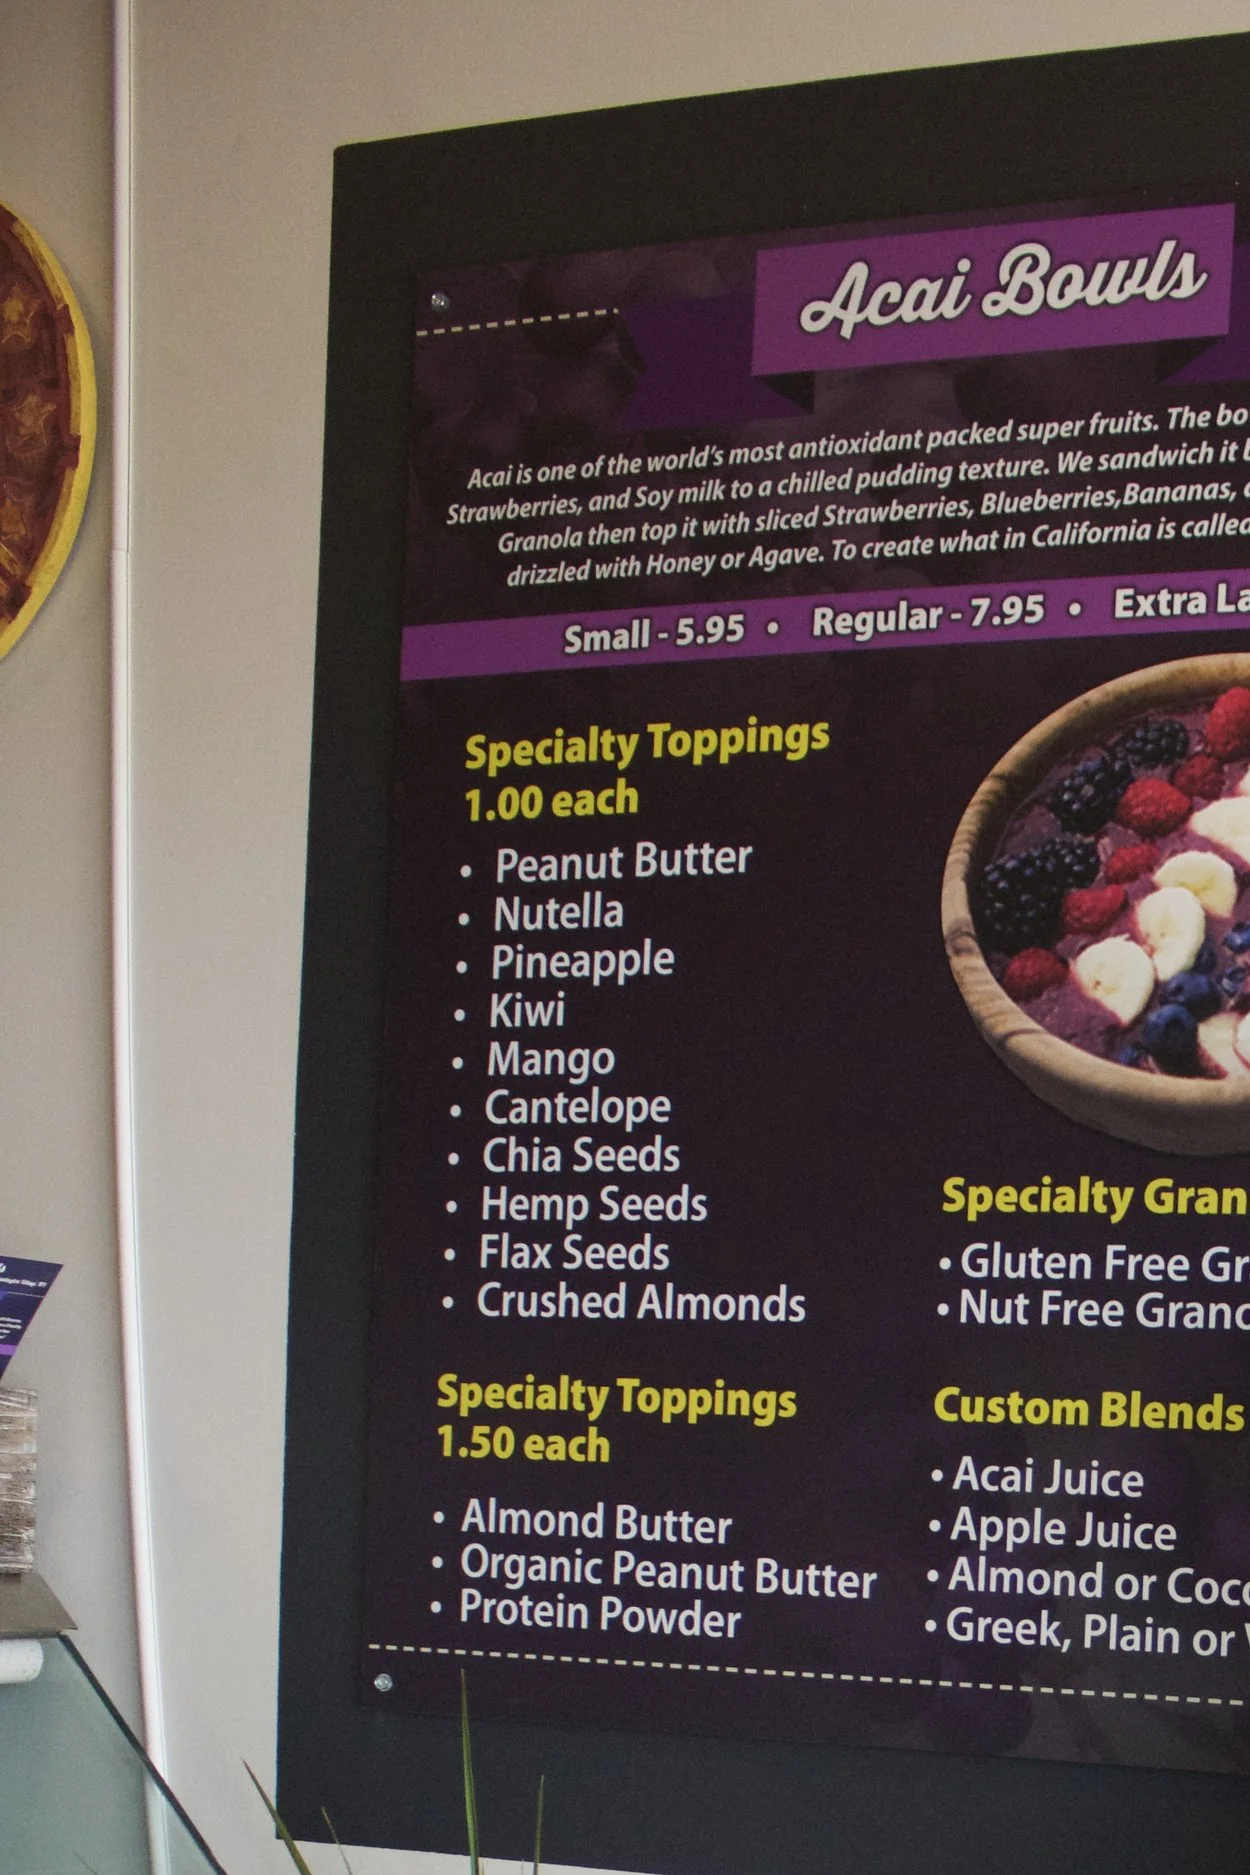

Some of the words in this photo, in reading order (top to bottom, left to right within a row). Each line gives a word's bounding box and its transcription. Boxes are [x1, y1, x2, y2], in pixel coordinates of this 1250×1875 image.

[801, 259, 971, 339] Acai
[982, 241, 1207, 316] Bowls
[467, 465, 513, 489] Acai
[516, 464, 532, 484] is
[537, 464, 576, 482] one
[581, 455, 605, 478] of
[608, 454, 642, 475] the
[729, 442, 784, 464] most
[789, 430, 923, 459] antioxidant
[926, 419, 1013, 453] packed
[1017, 420, 1084, 444] super
[1089, 411, 1158, 435] fruits.
[1168, 406, 1211, 429] The
[447, 495, 582, 524] Strawberries,
[589, 487, 631, 511] and
[635, 486, 674, 511] Soy
[678, 479, 725, 503] milk
[731, 480, 753, 499] to
[759, 481, 772, 496] a
[778, 468, 852, 495] chilled
[855, 462, 952, 494] pudding
[959, 459, 1049, 480] texture.
[1059, 451, 1093, 473] We
[1098, 441, 1214, 471] sandwich
[1220, 440, 1238, 462] it
[499, 527, 582, 553] Granola
[589, 524, 635, 545] then
[642, 523, 677, 545] top
[682, 517, 698, 537] it
[703, 512, 750, 535] with
[755, 505, 819, 531] sliced
[823, 496, 973, 526] Strawberries,
[507, 559, 591, 586] drizzled
[596, 555, 641, 579] with
[646, 554, 716, 576] Honey
[721, 553, 745, 569] or
[748, 546, 824, 571] Agave.
[833, 539, 856, 560] To
[862, 536, 934, 558] create
[940, 530, 999, 553] what
[1004, 527, 1025, 549] in
[1032, 519, 1151, 547] California
[1157, 517, 1176, 539] is
[565, 619, 649, 653] Small
[677, 615, 744, 645] 5.95
[814, 601, 943, 641] Regular
[972, 595, 1043, 626] 7.95
[1115, 589, 1206, 618] Extra
[466, 726, 639, 777] Specialty
[647, 716, 829, 765] Toppings
[466, 786, 543, 821] 1.00
[552, 778, 638, 817] each
[497, 847, 623, 883] Peanut
[635, 842, 753, 877] Butter
[495, 891, 623, 931] Nutella
[493, 938, 674, 986] Pineapple
[491, 991, 564, 1027] Kiwi
[488, 1041, 615, 1084] Mango
[486, 1086, 671, 1132] Cantelope
[484, 1136, 561, 1172] Chia
[573, 1135, 680, 1172] Seeds
[483, 1186, 588, 1230] Hemp
[600, 1184, 707, 1221] Seeds
[943, 1176, 1134, 1223] Specialty
[481, 1233, 552, 1268] Flax
[563, 1233, 669, 1270] Seeds
[962, 1242, 1091, 1279] Gluten
[1106, 1245, 1189, 1281] Free
[478, 1281, 626, 1318] Crushed
[637, 1283, 805, 1322] Almonds
[960, 1289, 1029, 1325] Nut
[1042, 1290, 1124, 1327] Free
[438, 1374, 609, 1421] Specialty
[617, 1378, 796, 1426] Toppings
[935, 1387, 1088, 1425] Custom
[1101, 1391, 1244, 1431] Blends
[438, 1425, 514, 1459] 1.50
[524, 1427, 610, 1462] each
[953, 1456, 1033, 1492] Acai
[1044, 1459, 1143, 1497] Juice
[461, 1497, 604, 1538] Almond
[616, 1505, 732, 1544] Butter
[951, 1506, 1066, 1552] Apple
[1076, 1512, 1176, 1550] Juice
[462, 1543, 602, 1589] Organic
[614, 1551, 744, 1592] Peanut
[756, 1558, 877, 1598] Butter
[948, 1556, 1103, 1598] Almond
[1115, 1574, 1157, 1600] or
[461, 1588, 588, 1629] Protein
[601, 1596, 741, 1637] Powder
[947, 1607, 1071, 1652] Greek,
[1084, 1614, 1179, 1653] Plain
[1193, 1630, 1235, 1656] or
